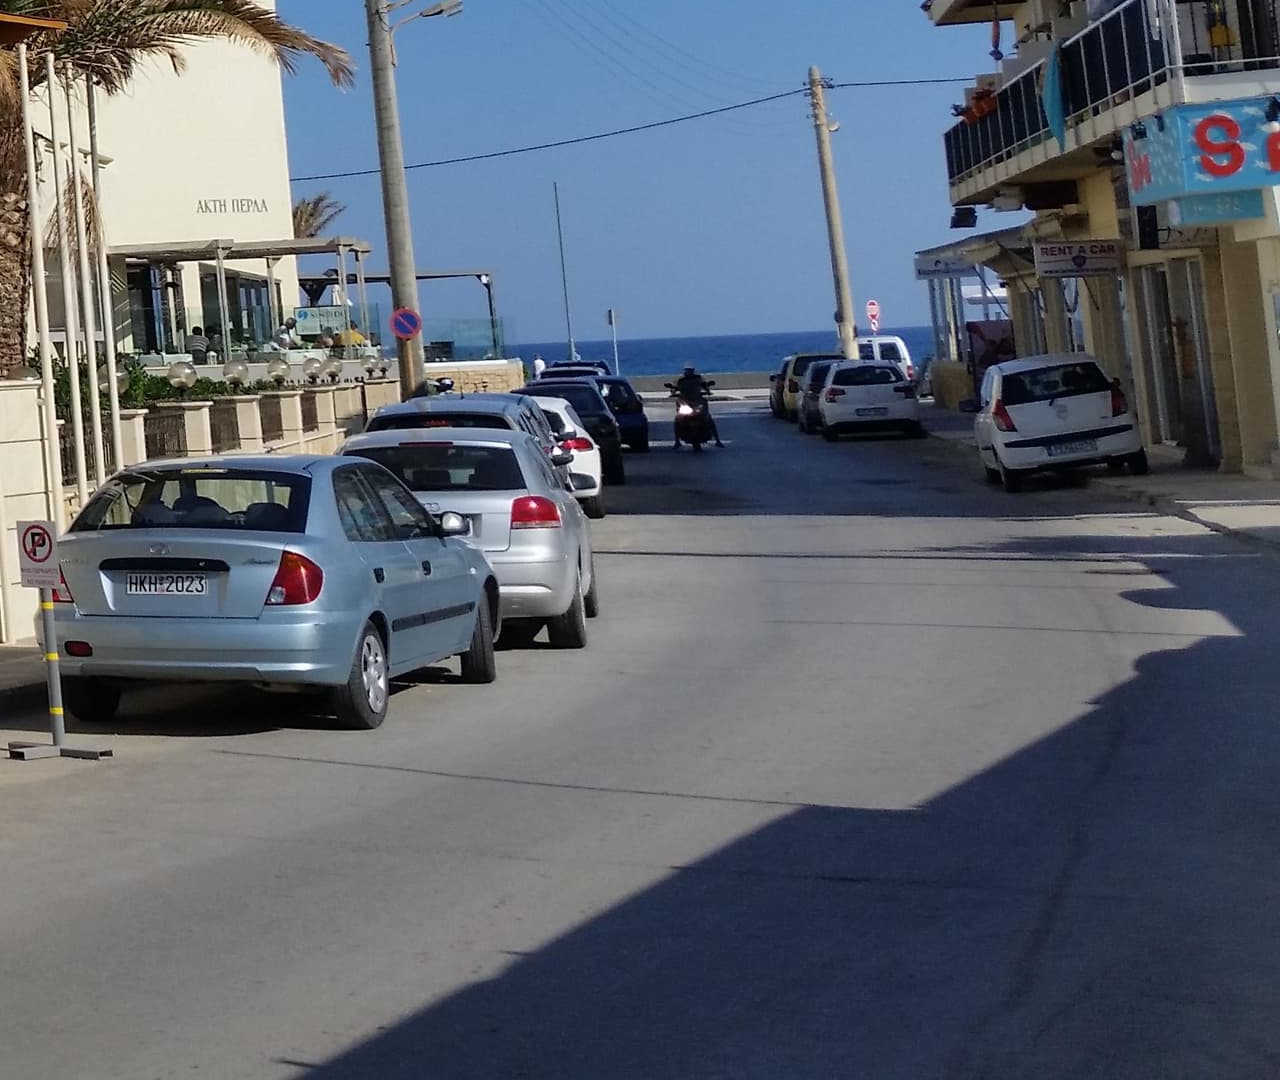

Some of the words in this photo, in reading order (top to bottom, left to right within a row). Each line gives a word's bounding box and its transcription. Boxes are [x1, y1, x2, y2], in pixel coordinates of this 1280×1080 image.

[1040, 245, 1074, 257] RENT
[1077, 245, 1087, 255] A
[1089, 243, 1116, 255] CAR
